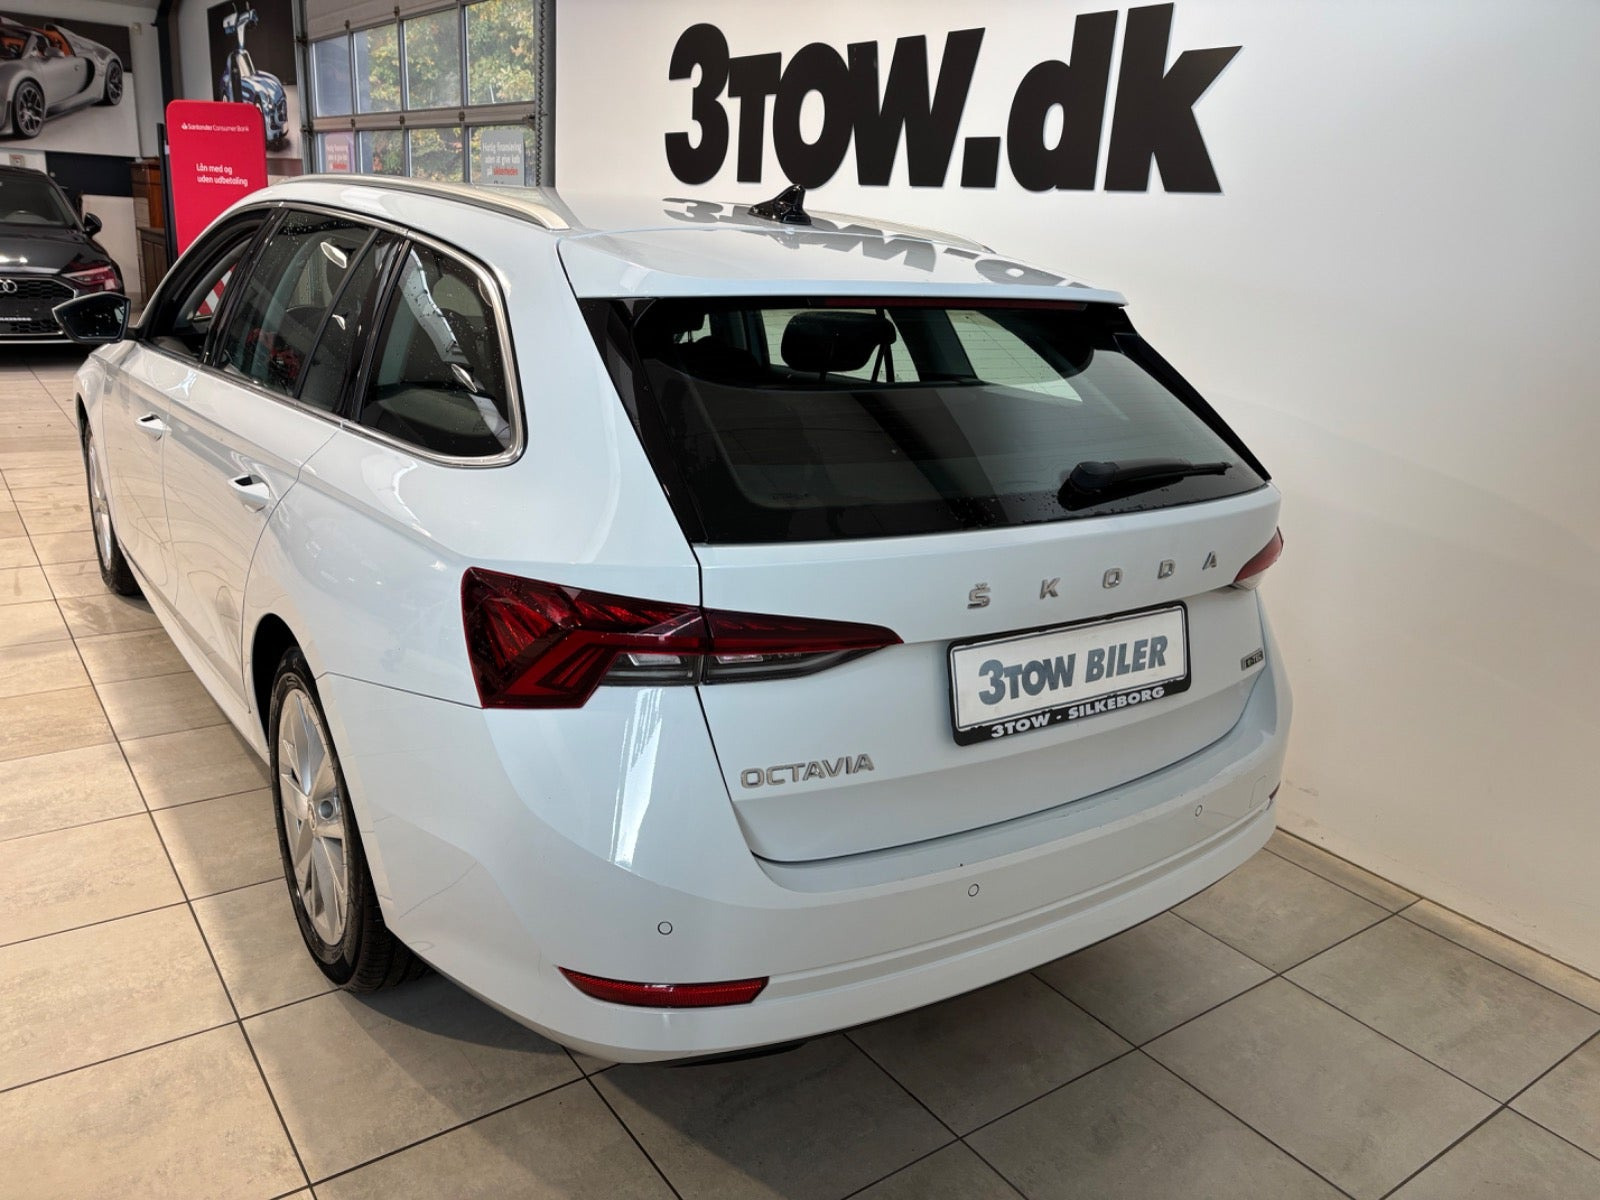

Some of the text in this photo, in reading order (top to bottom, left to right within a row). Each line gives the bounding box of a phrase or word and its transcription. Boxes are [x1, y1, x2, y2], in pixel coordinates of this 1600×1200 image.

[664, 3, 1243, 193] 3TOW.dk
[187, 123, 213, 131] Santander
[196, 163, 233, 176] Lån med og
[197, 175, 249, 188] uden udbetaling
[978, 635, 1168, 705] 3TOW BILER
[991, 712, 1050, 738] 3TOW
[1068, 686, 1165, 720] SILKEBORG
[740, 753, 875, 789] OCTAVIA
